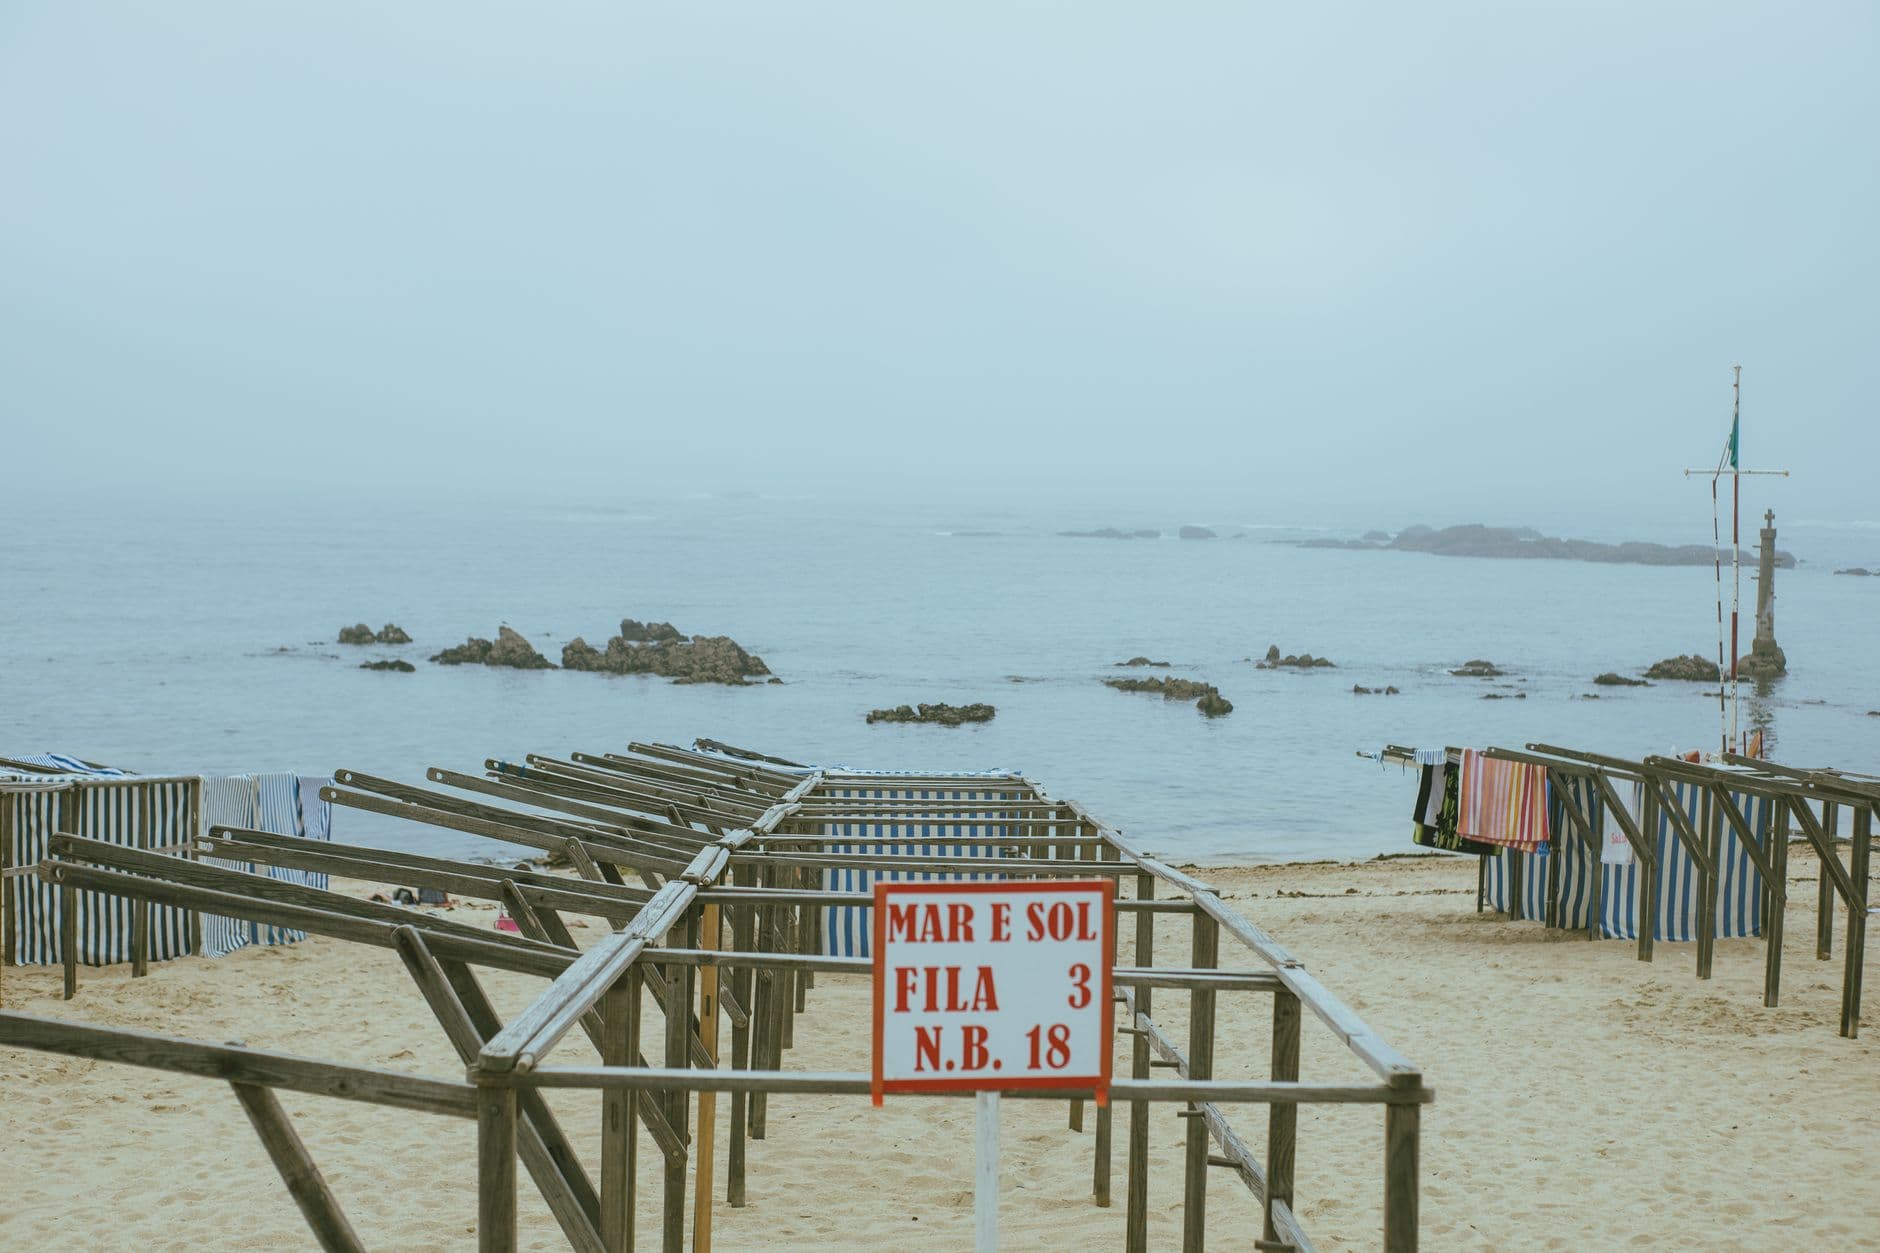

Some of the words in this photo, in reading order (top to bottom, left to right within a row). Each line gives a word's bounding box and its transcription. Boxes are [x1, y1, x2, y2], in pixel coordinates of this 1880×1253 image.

[888, 903, 975, 943] MAR
[989, 903, 1012, 942] E
[1026, 902, 1096, 941] SOL
[894, 966, 999, 1012] FILA
[1067, 963, 1092, 1009] 3
[914, 1026, 1002, 1071] N.B.
[1025, 1023, 1071, 1070] 18
